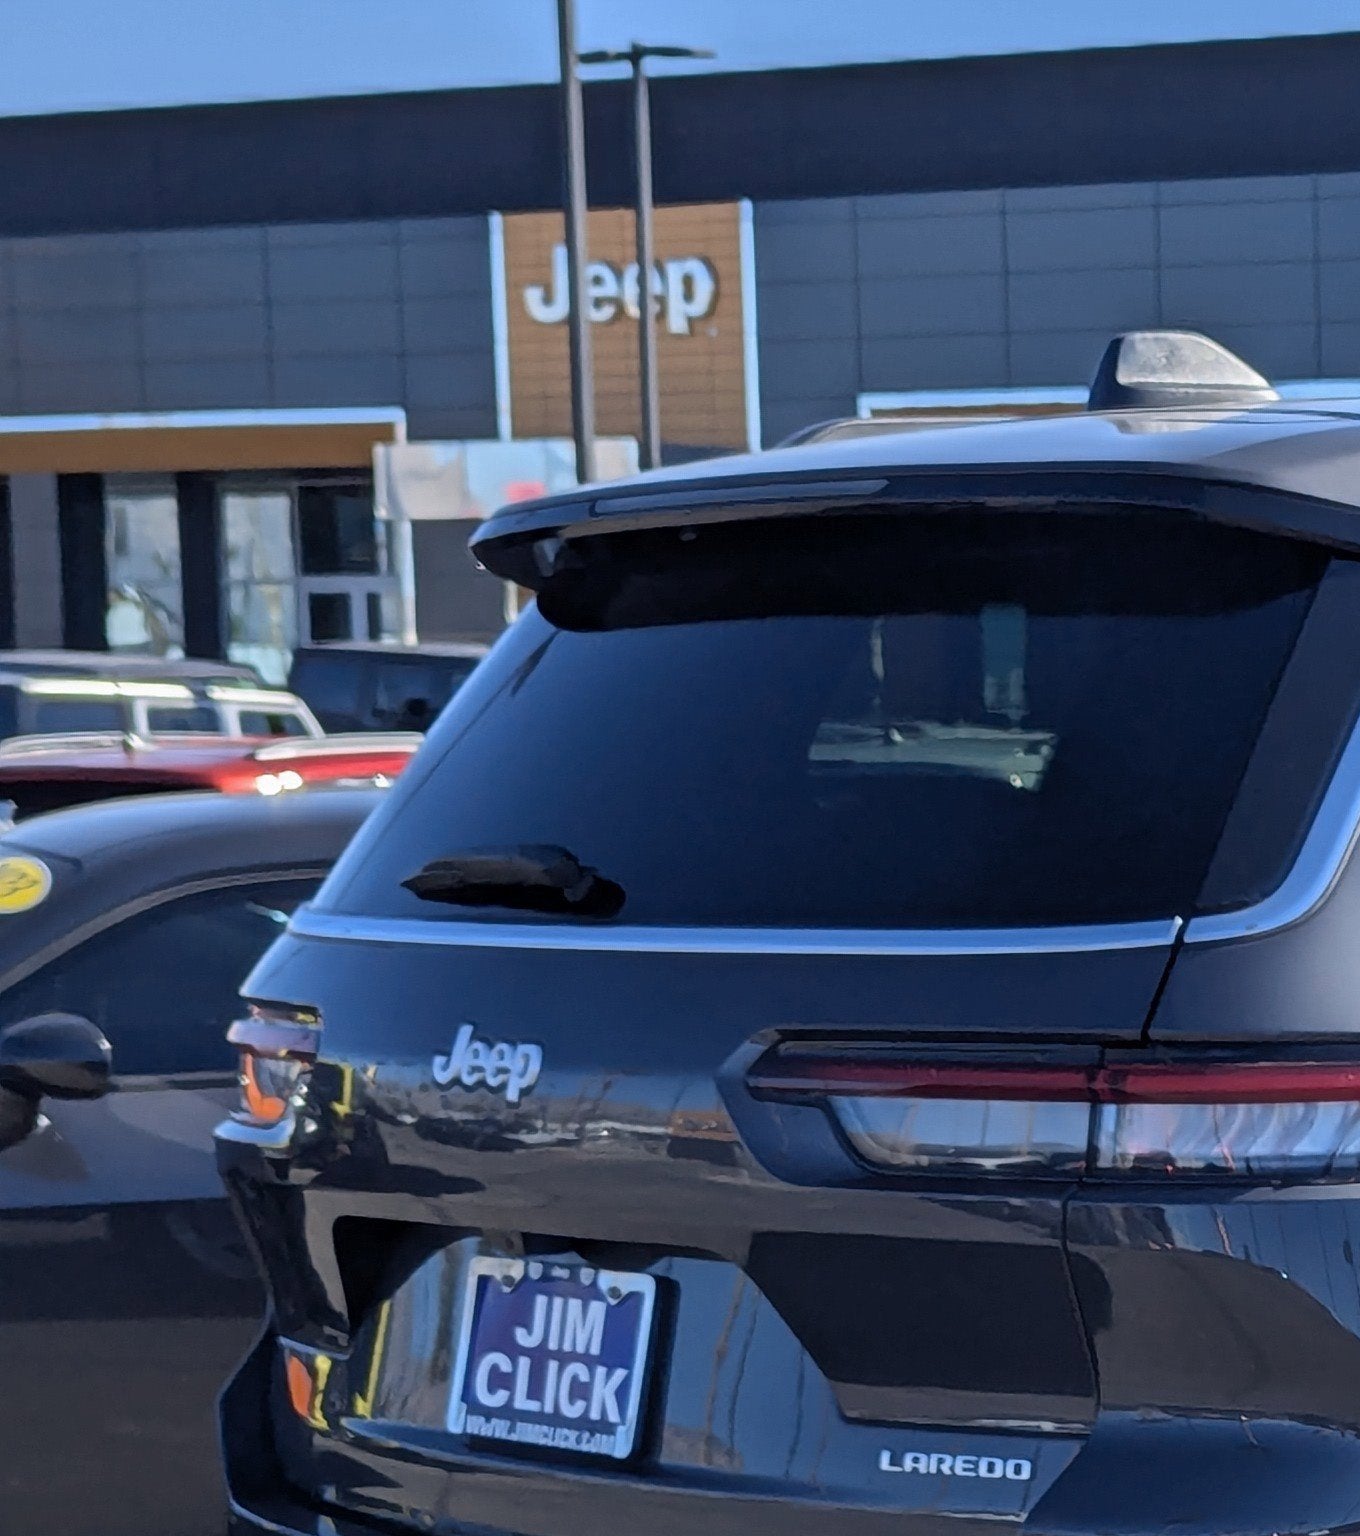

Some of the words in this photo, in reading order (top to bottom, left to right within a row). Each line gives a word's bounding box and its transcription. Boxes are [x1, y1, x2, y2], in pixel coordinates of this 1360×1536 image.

[523, 243, 715, 335] Jeep
[432, 1023, 542, 1103] Jeep
[514, 1294, 608, 1356] JIM
[475, 1351, 630, 1424] CLICK
[879, 1449, 1032, 1481] LAREDO
